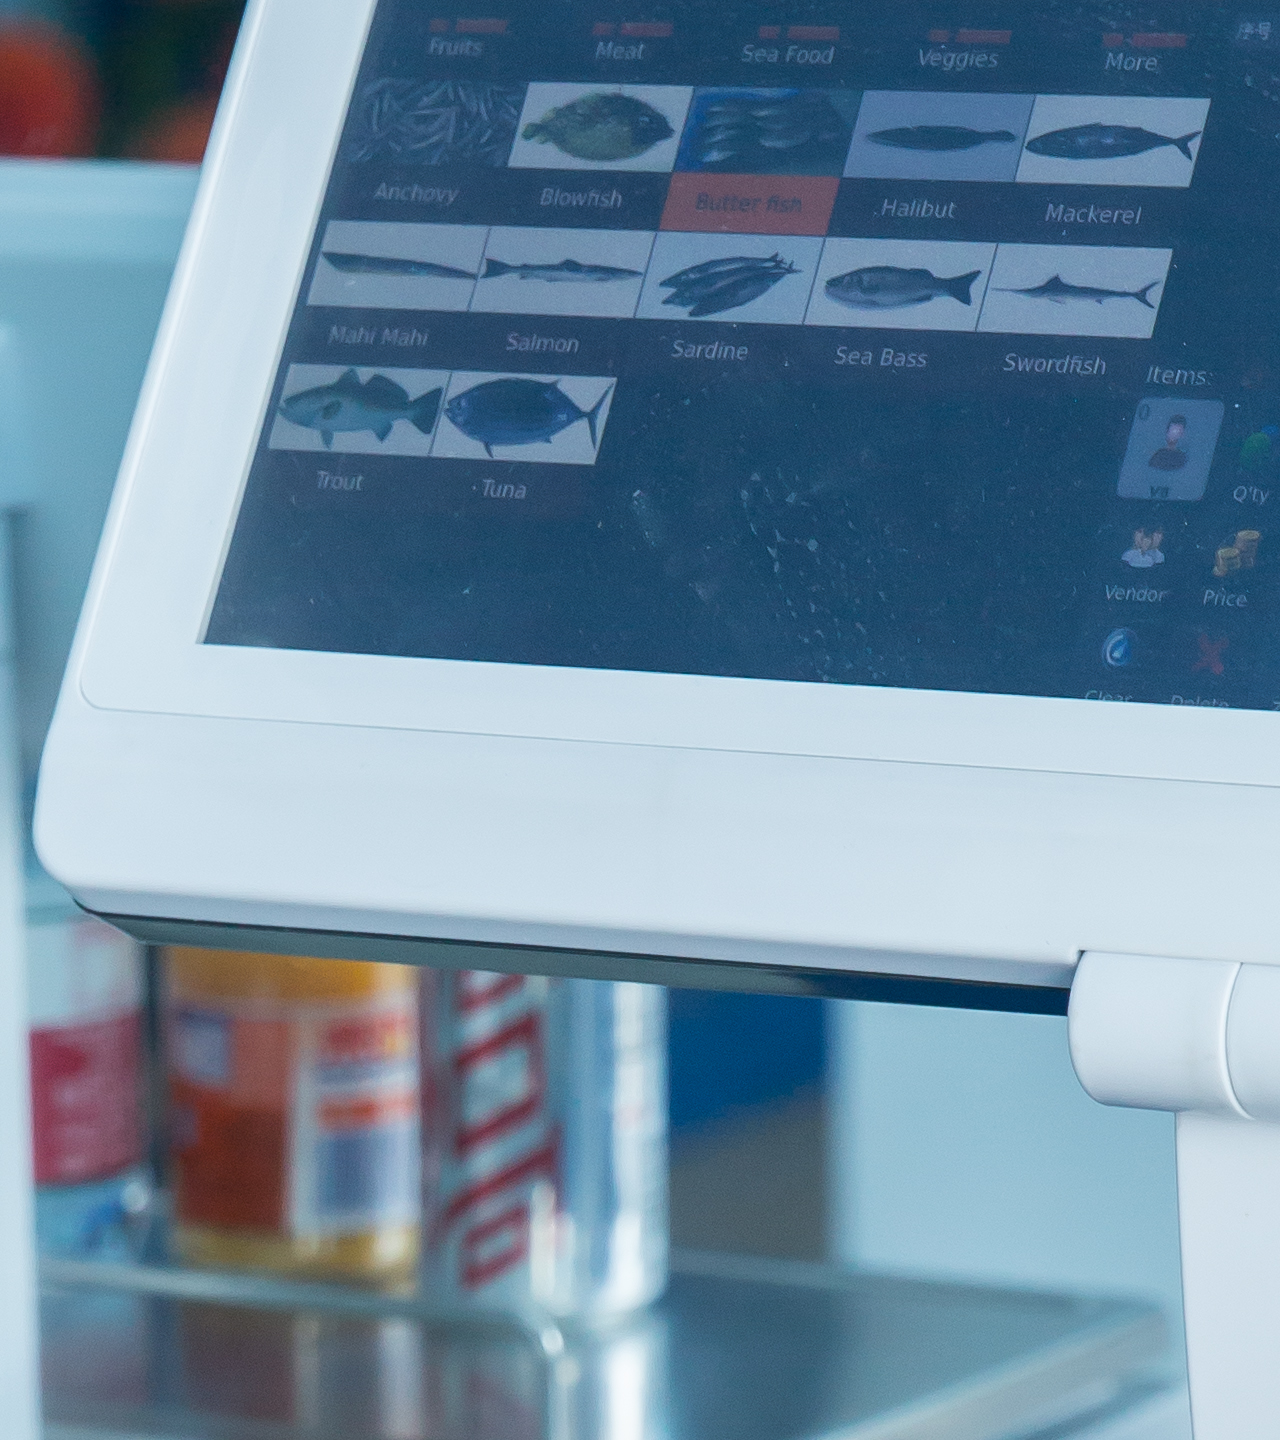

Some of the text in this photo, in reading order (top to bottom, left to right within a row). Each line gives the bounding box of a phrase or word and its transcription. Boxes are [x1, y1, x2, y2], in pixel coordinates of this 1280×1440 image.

[429, 37, 483, 57] Fruits
[595, 40, 646, 61] Meat
[740, 43, 836, 65] Sea Food
[919, 48, 999, 71] Veggies
[1105, 51, 1158, 72] More
[373, 181, 460, 207] Anchovy
[539, 185, 623, 209] Blowfish
[695, 191, 803, 214] Butter fish
[880, 197, 956, 220] Halibut
[1045, 202, 1143, 227] Mackerel
[329, 324, 429, 348] Mahi Mahi
[506, 331, 580, 355] Salmon
[670, 338, 749, 362] Sardine
[834, 344, 928, 369] Sea Bass
[1004, 352, 1108, 377] Swordfish
[1145, 365, 1214, 386] Items:
[316, 469, 365, 492] Trout
[481, 477, 528, 500] Tuna
[1104, 584, 1168, 604] Vendor
[1203, 587, 1249, 608] Price
